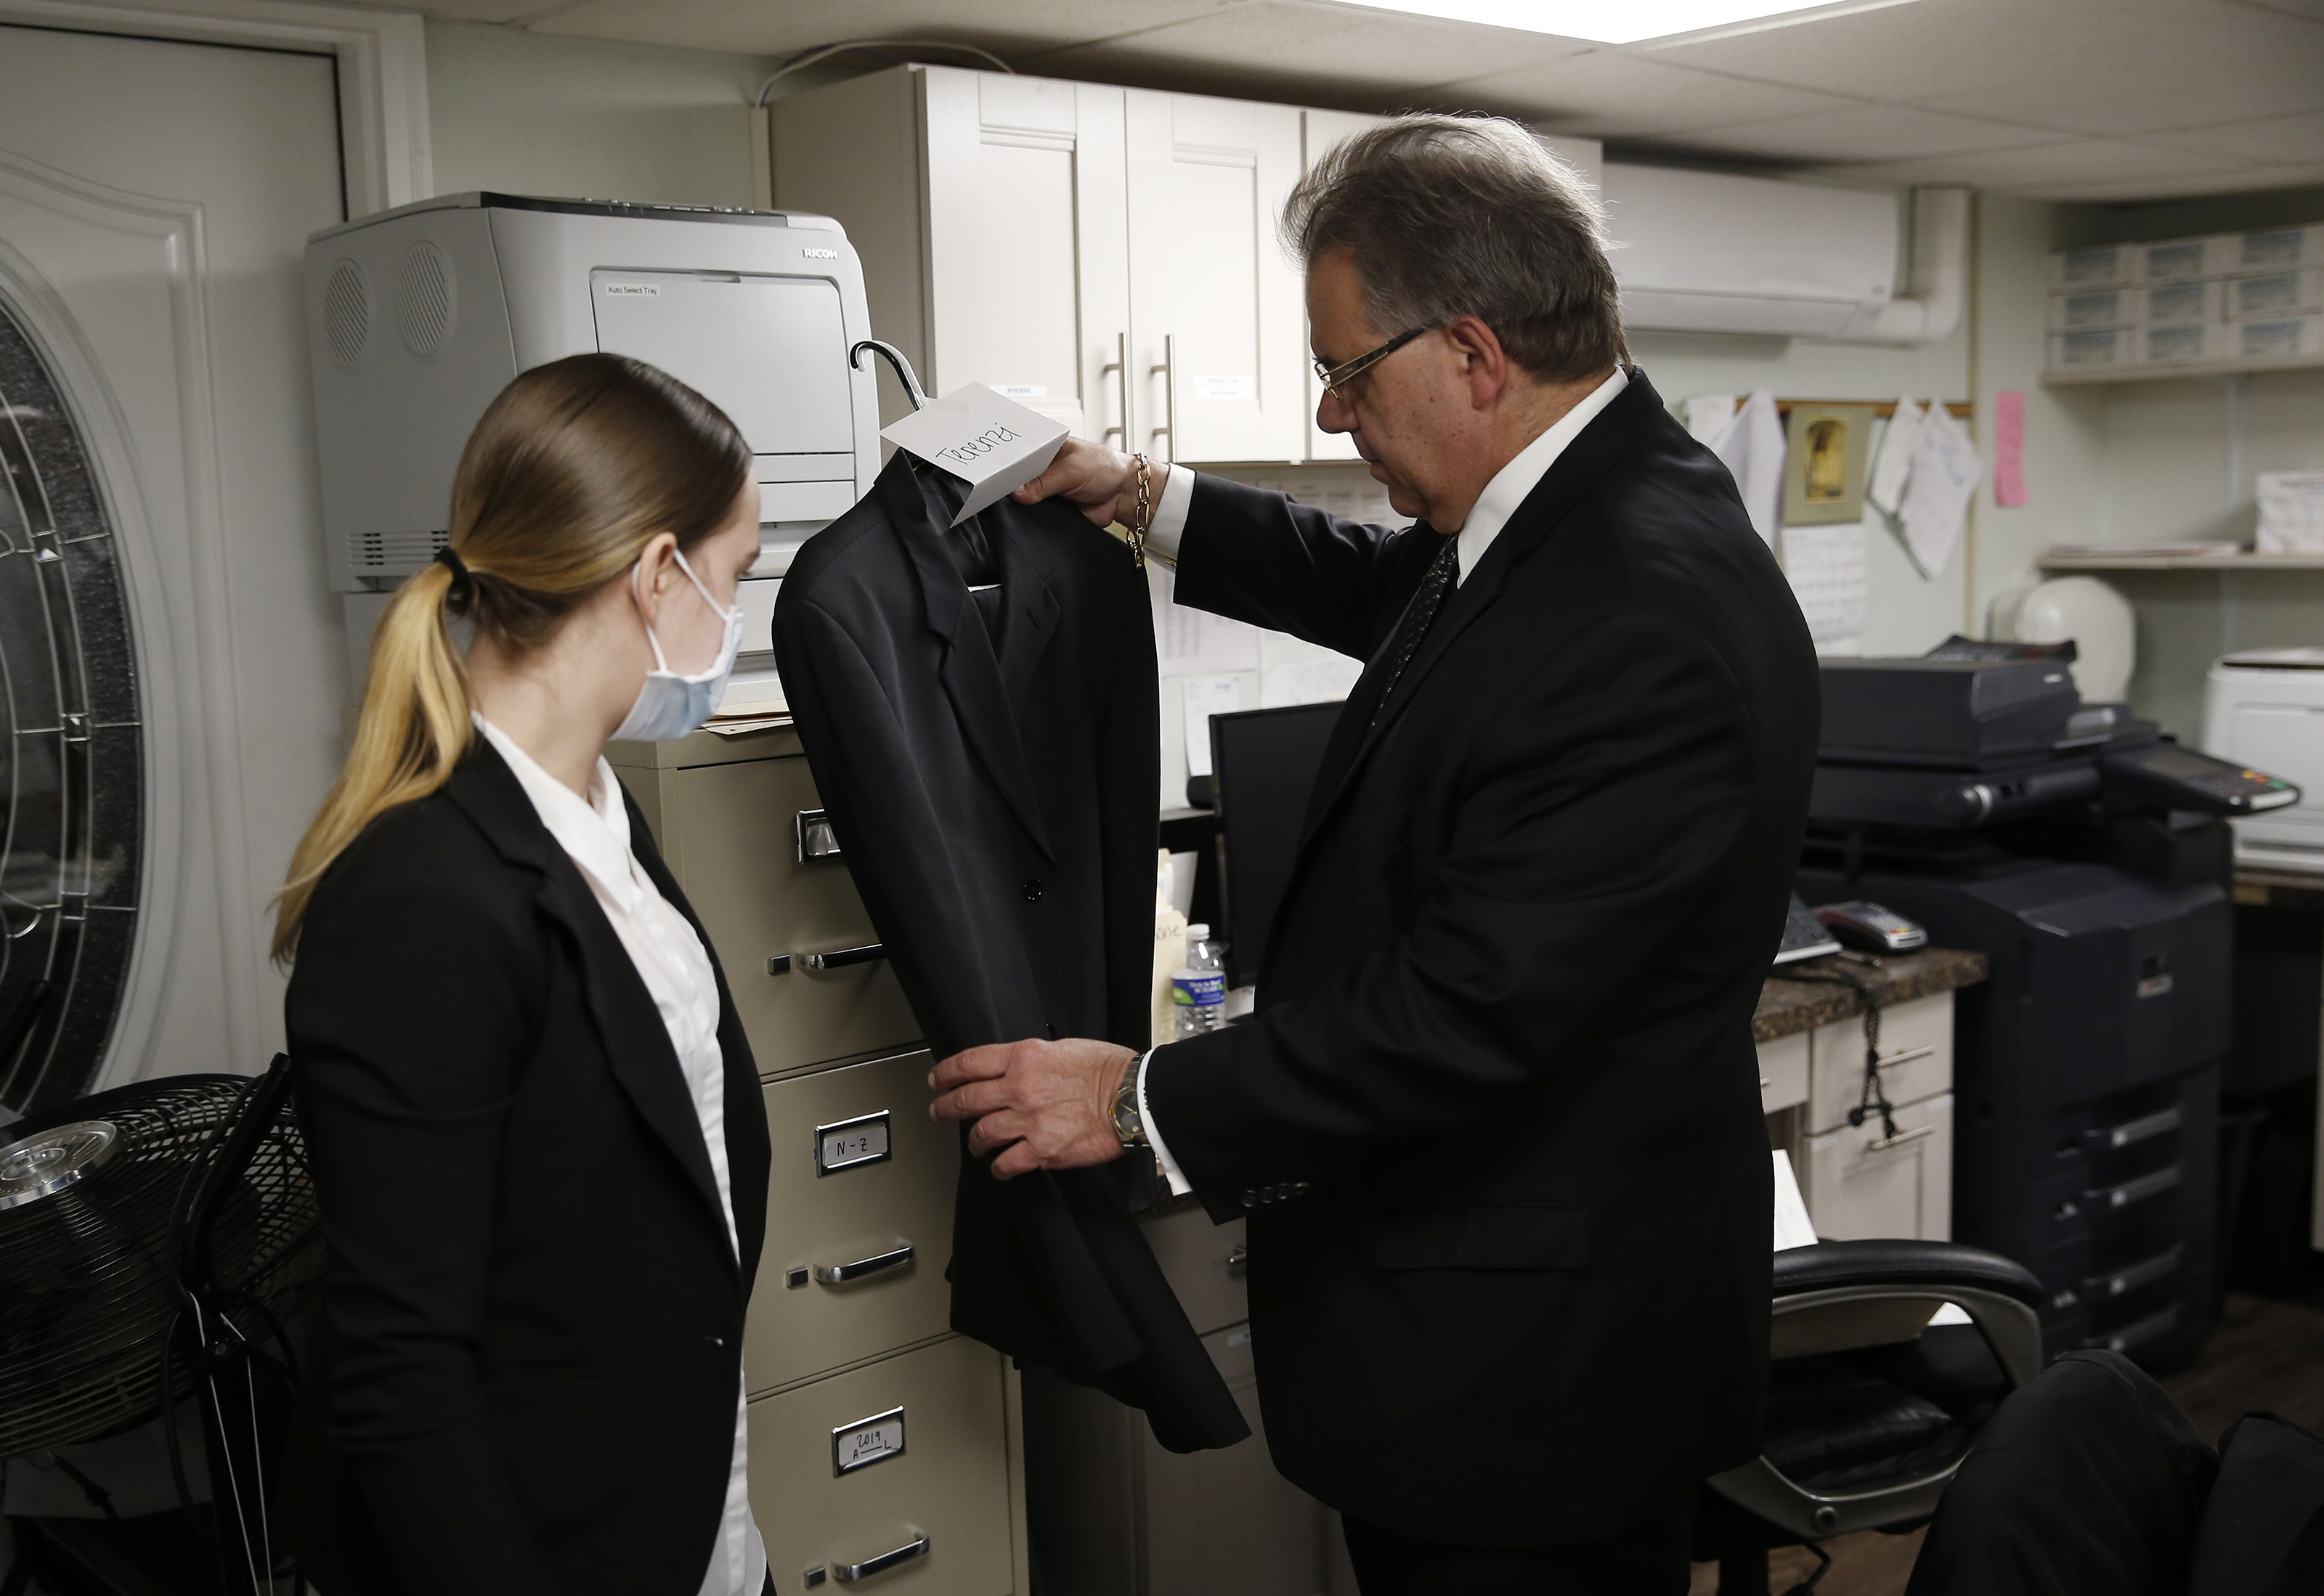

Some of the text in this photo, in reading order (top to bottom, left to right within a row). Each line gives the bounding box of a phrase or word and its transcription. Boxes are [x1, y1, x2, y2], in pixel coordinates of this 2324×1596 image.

[803, 248, 838, 259] RICOH
[644, 287, 657, 296] Tray
[935, 422, 1022, 465] Terenzi
[857, 1430, 880, 1448] 2019
